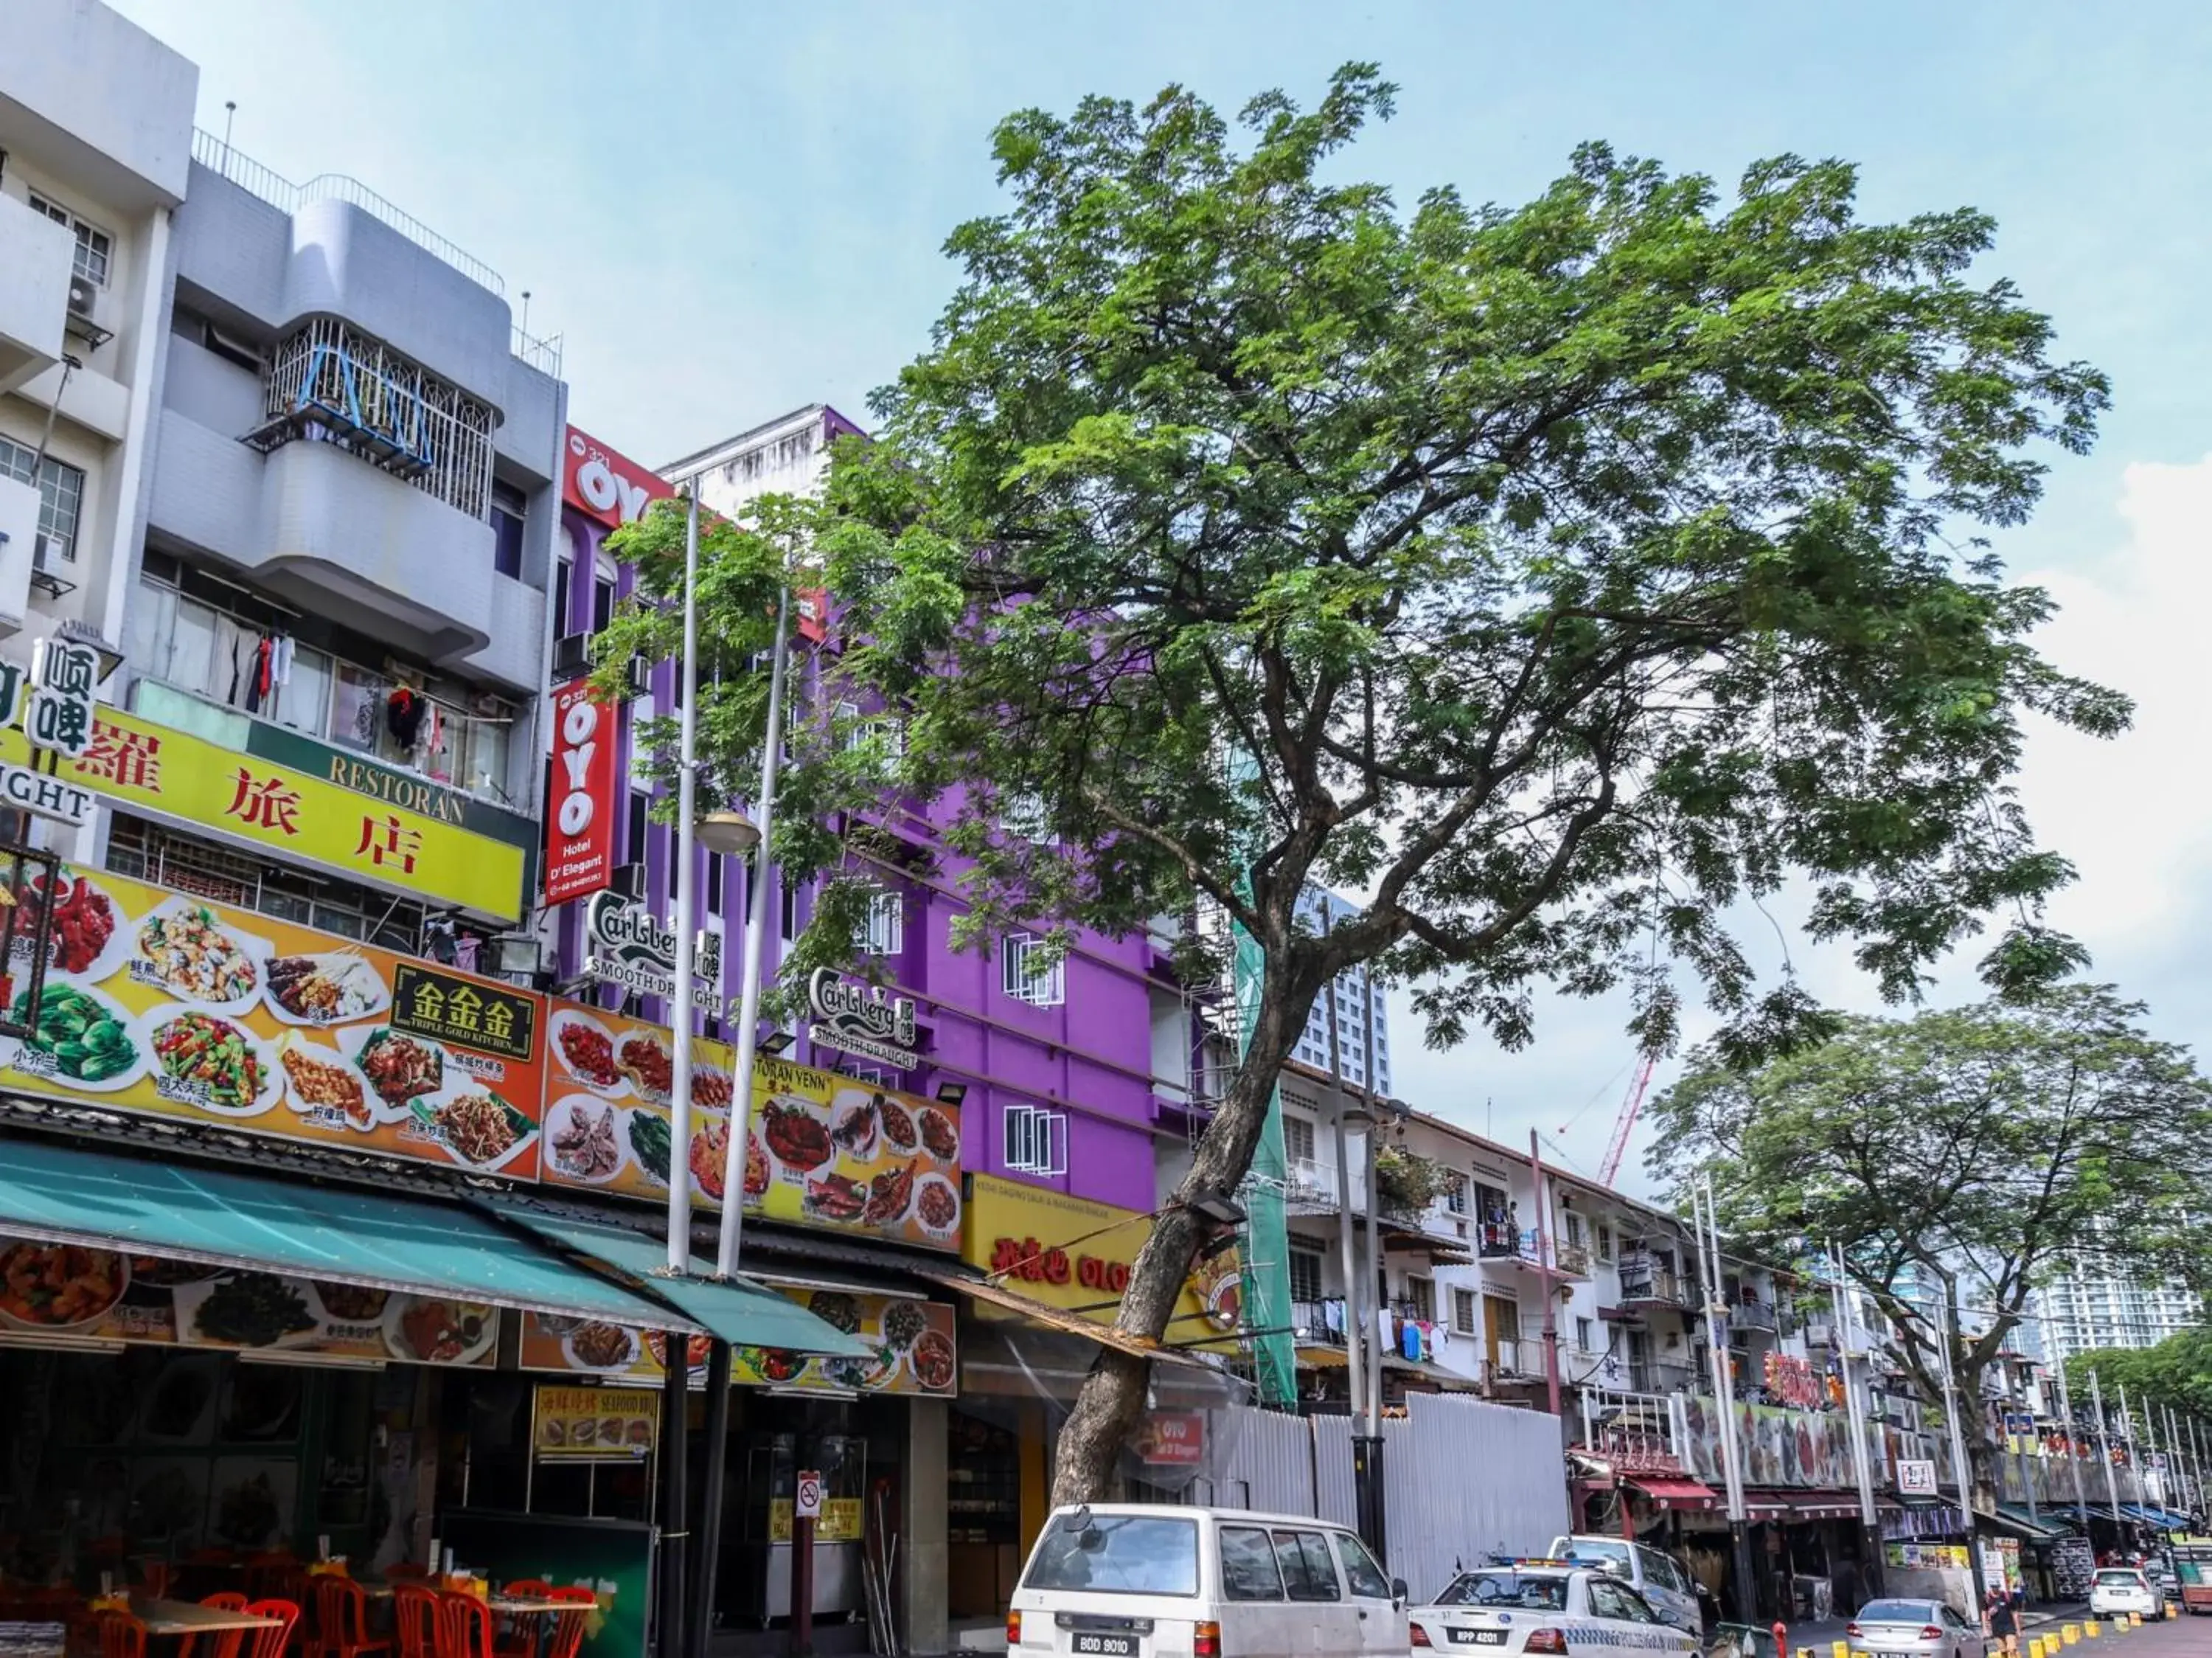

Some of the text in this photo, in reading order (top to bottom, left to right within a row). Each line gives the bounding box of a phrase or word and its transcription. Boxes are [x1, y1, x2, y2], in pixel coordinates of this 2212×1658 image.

[577, 461, 650, 521] OY
[558, 701, 598, 836] OYO
[330, 755, 467, 825] RESTORAN
[563, 837, 591, 859] Hotel
[563, 853, 602, 878] Elegant
[657, 979, 722, 1009] DRGHT
[815, 968, 895, 1033] Carlsberg
[412, 981, 515, 1040] 金金金
[411, 1017, 514, 1050] TRIPLE GOLD KITCHEN
[795, 1070, 825, 1092] YENN
[1103, 1638, 1128, 1654] 9010
[1476, 1632, 1498, 1643] 4201
